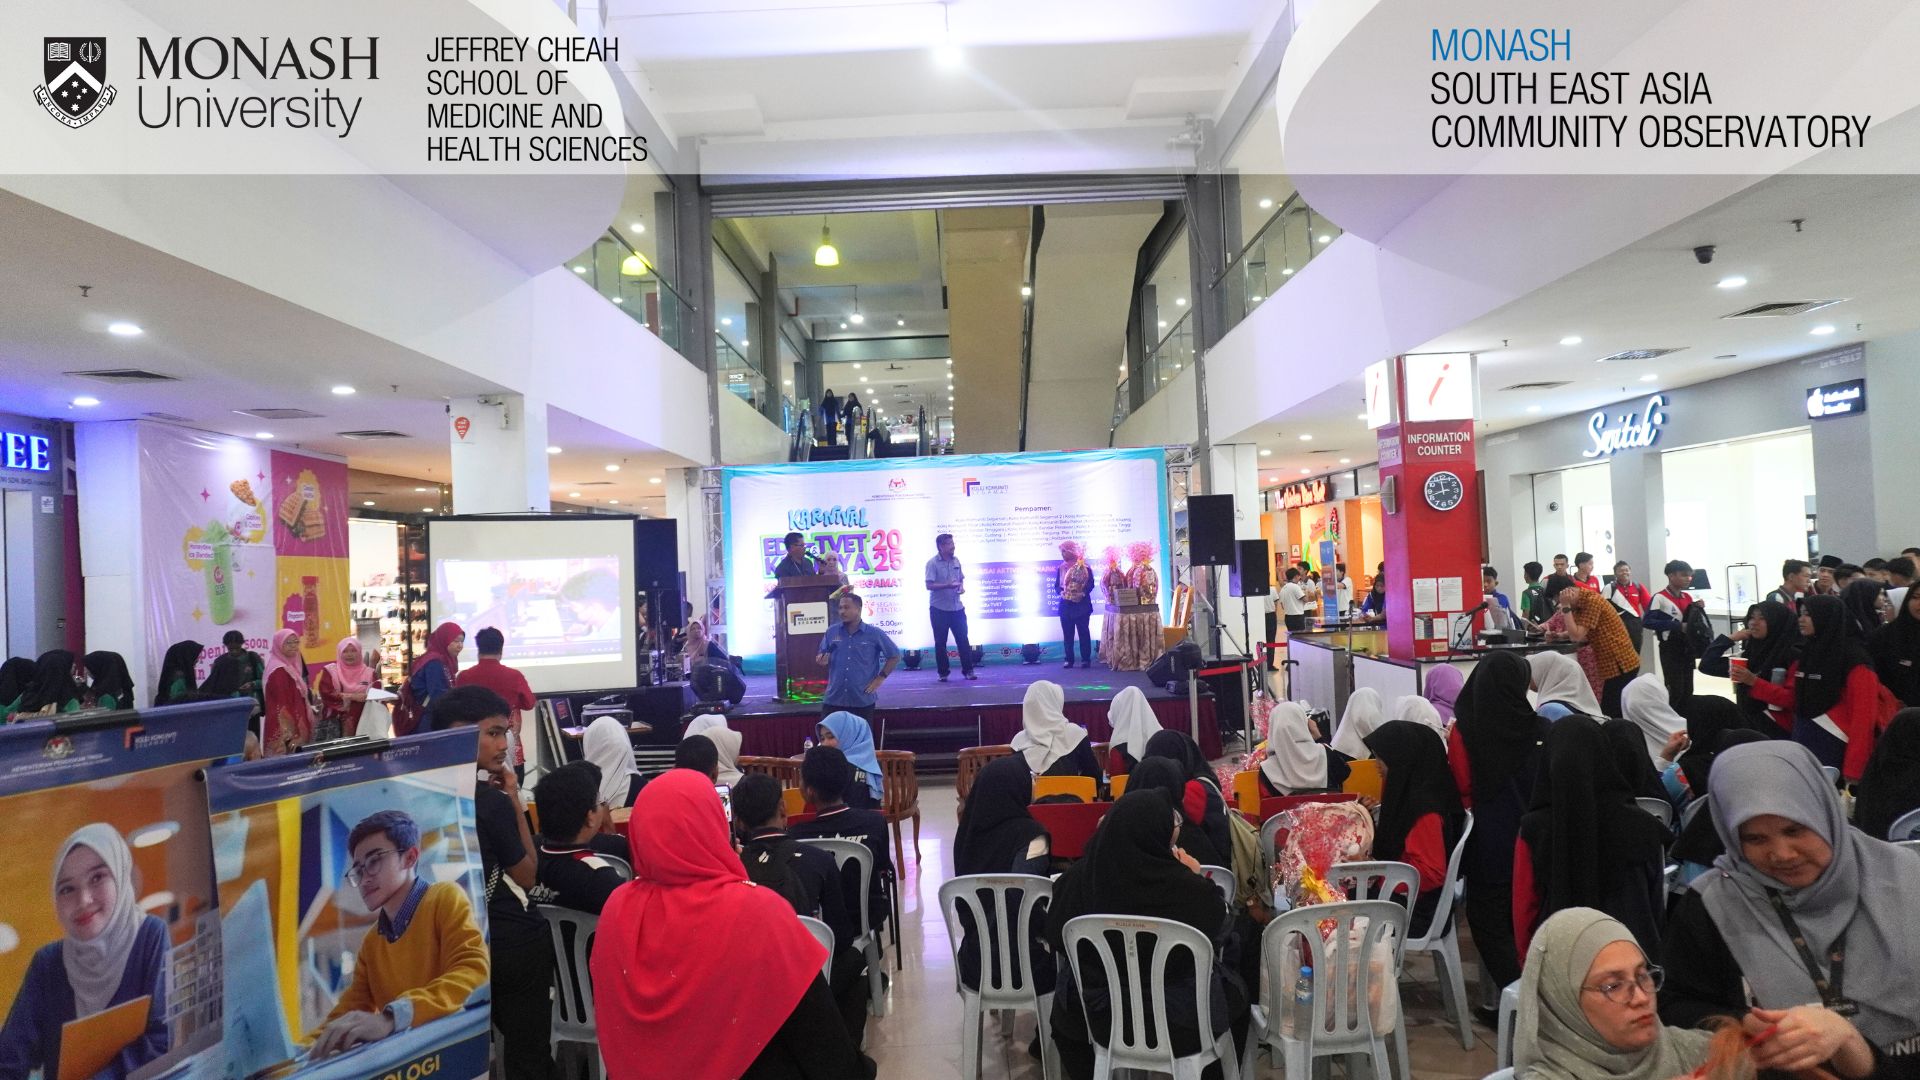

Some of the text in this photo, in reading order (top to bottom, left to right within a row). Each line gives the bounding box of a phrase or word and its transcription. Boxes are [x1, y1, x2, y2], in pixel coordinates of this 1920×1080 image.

[1582, 395, 1664, 458] Switch
[1407, 432, 1470, 444] INFORMATION
[0, 432, 50, 471] EE
[1417, 445, 1462, 456] COUNTER
[788, 505, 869, 531] KARNIVAL
[871, 529, 903, 551] 20
[873, 549, 904, 572] 25
[244, 638, 269, 650] soon
